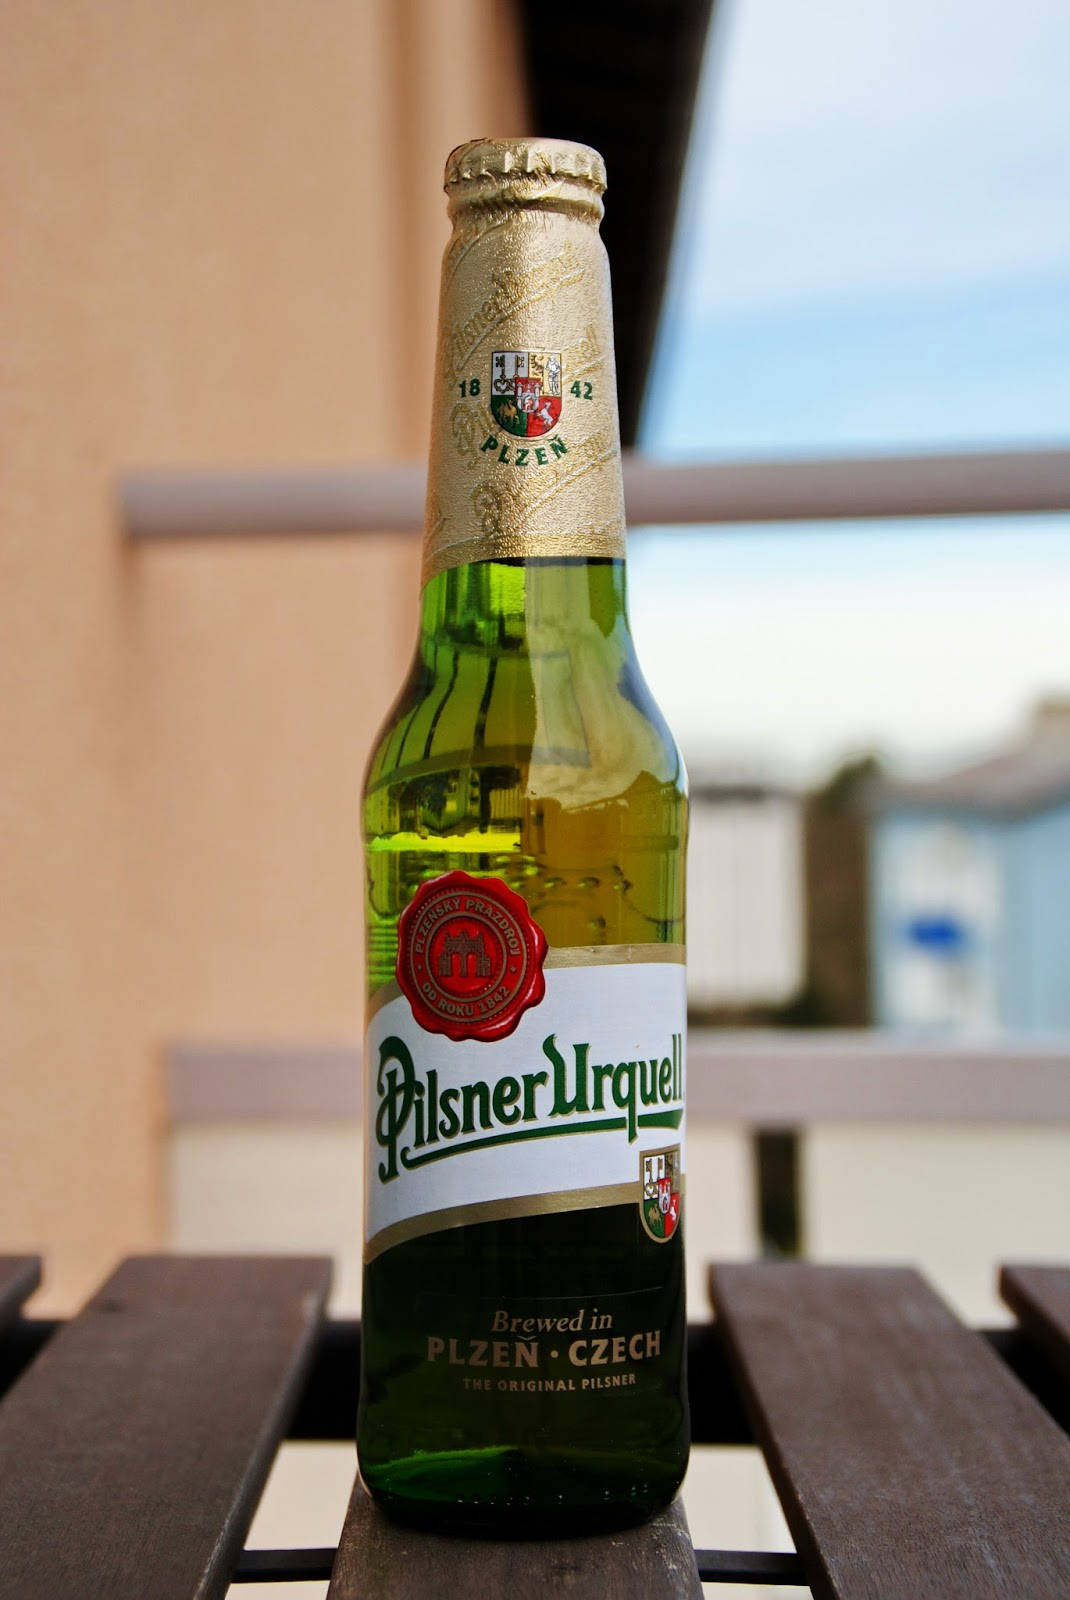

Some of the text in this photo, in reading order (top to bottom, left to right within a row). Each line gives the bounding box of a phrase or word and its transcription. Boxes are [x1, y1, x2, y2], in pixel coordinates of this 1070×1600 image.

[458, 378, 593, 400] 18 42
[465, 899, 521, 955] PRAZDROJ
[422, 982, 511, 1016] OD ROKU 1842
[375, 1033, 683, 1185] Pilsner Urquell
[491, 1307, 613, 1333] Brewed in
[426, 1330, 662, 1368] PLZEŇ CZECH
[463, 1373, 637, 1392] THE ORIGINAL PILSNER
